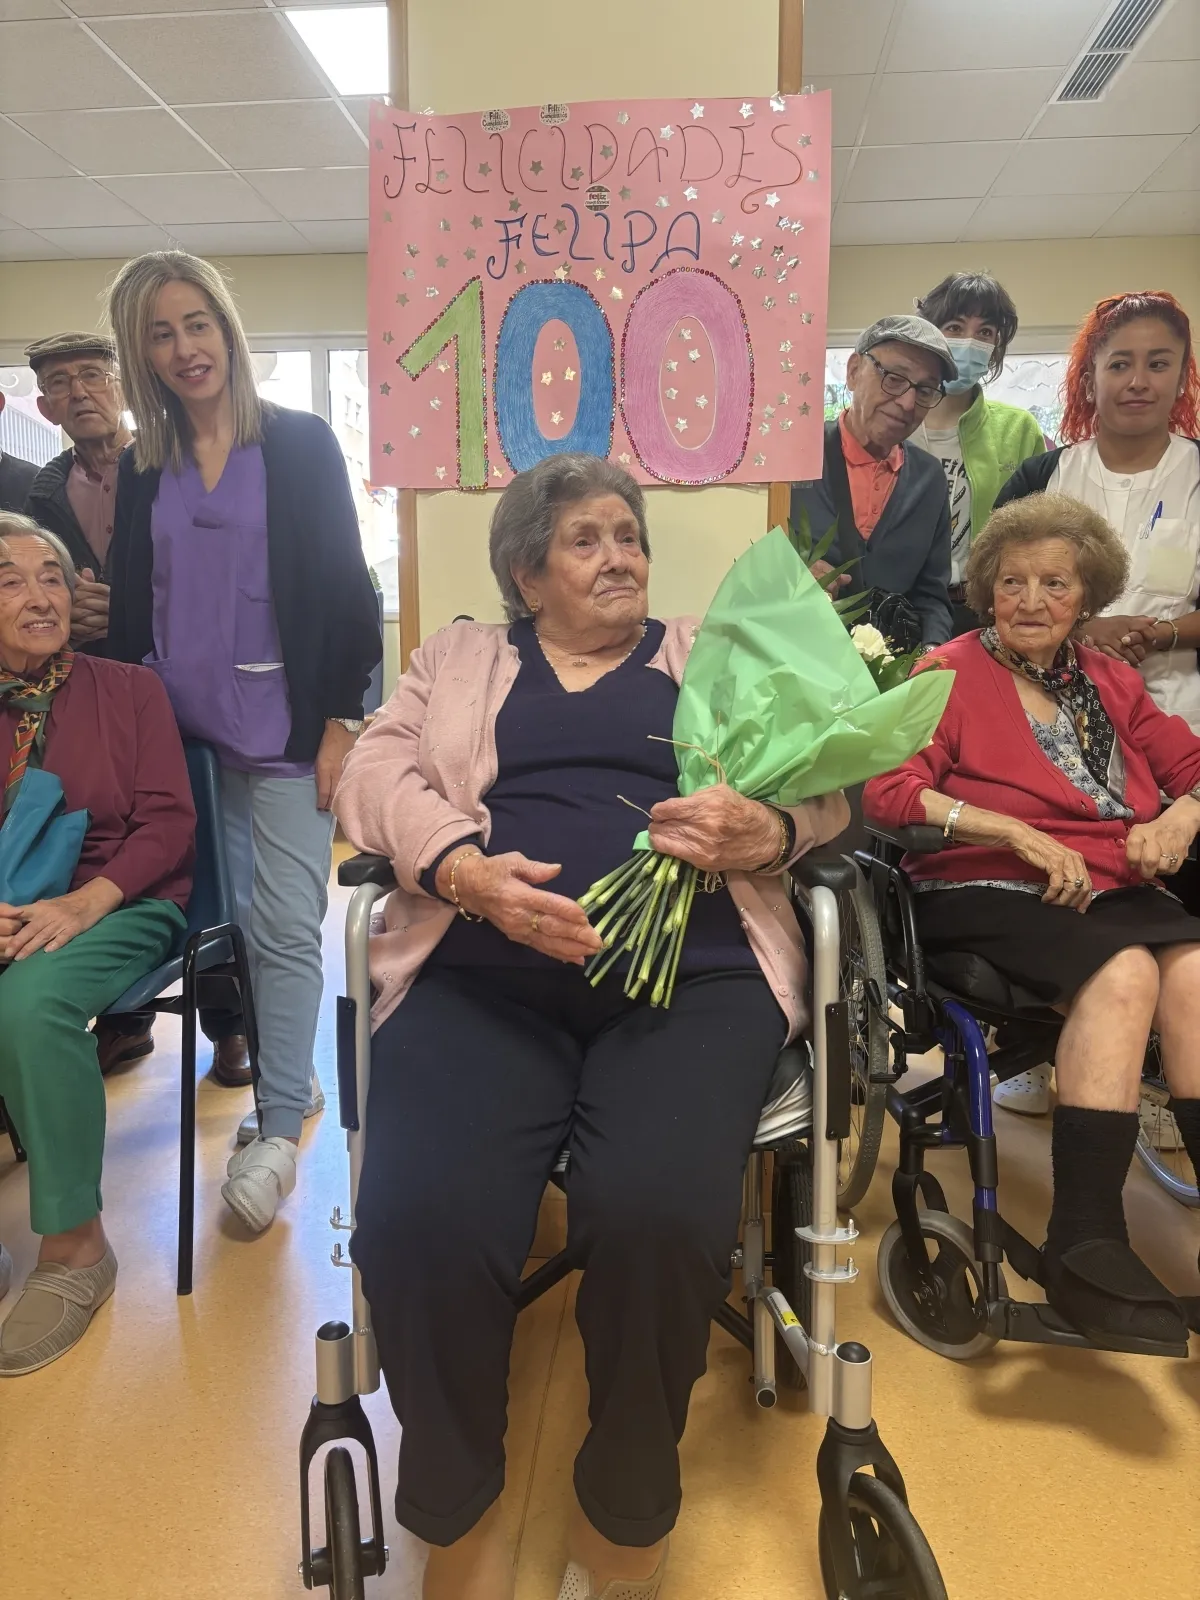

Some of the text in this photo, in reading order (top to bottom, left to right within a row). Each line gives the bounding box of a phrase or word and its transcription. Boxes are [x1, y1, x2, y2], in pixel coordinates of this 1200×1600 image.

[383, 121, 803, 214] FELICIDADES
[486, 203, 701, 280] FELIPA
[396, 267, 755, 490] 100
